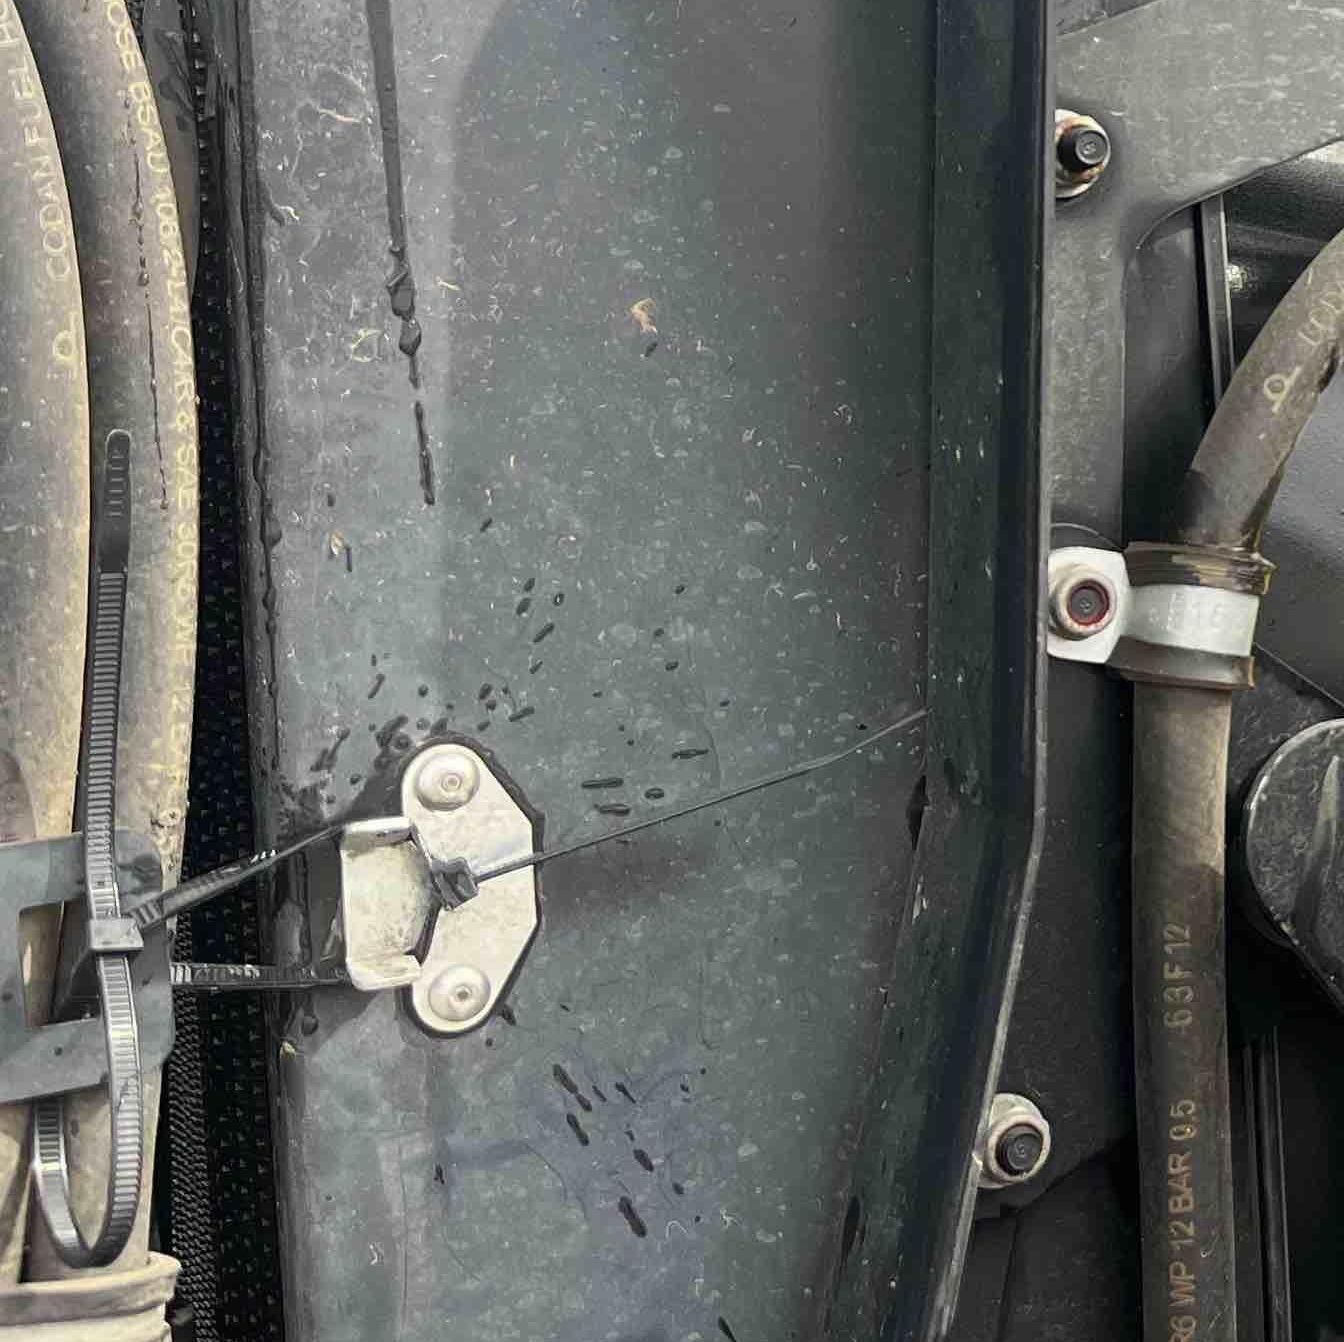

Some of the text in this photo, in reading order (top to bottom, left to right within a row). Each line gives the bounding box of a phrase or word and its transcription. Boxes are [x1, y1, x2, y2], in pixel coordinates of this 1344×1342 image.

[176, 444, 197, 510] SAE
[1167, 1153, 1195, 1215] BAR
[1168, 1220, 1196, 1251] 12
[1168, 1260, 1196, 1308] WP
